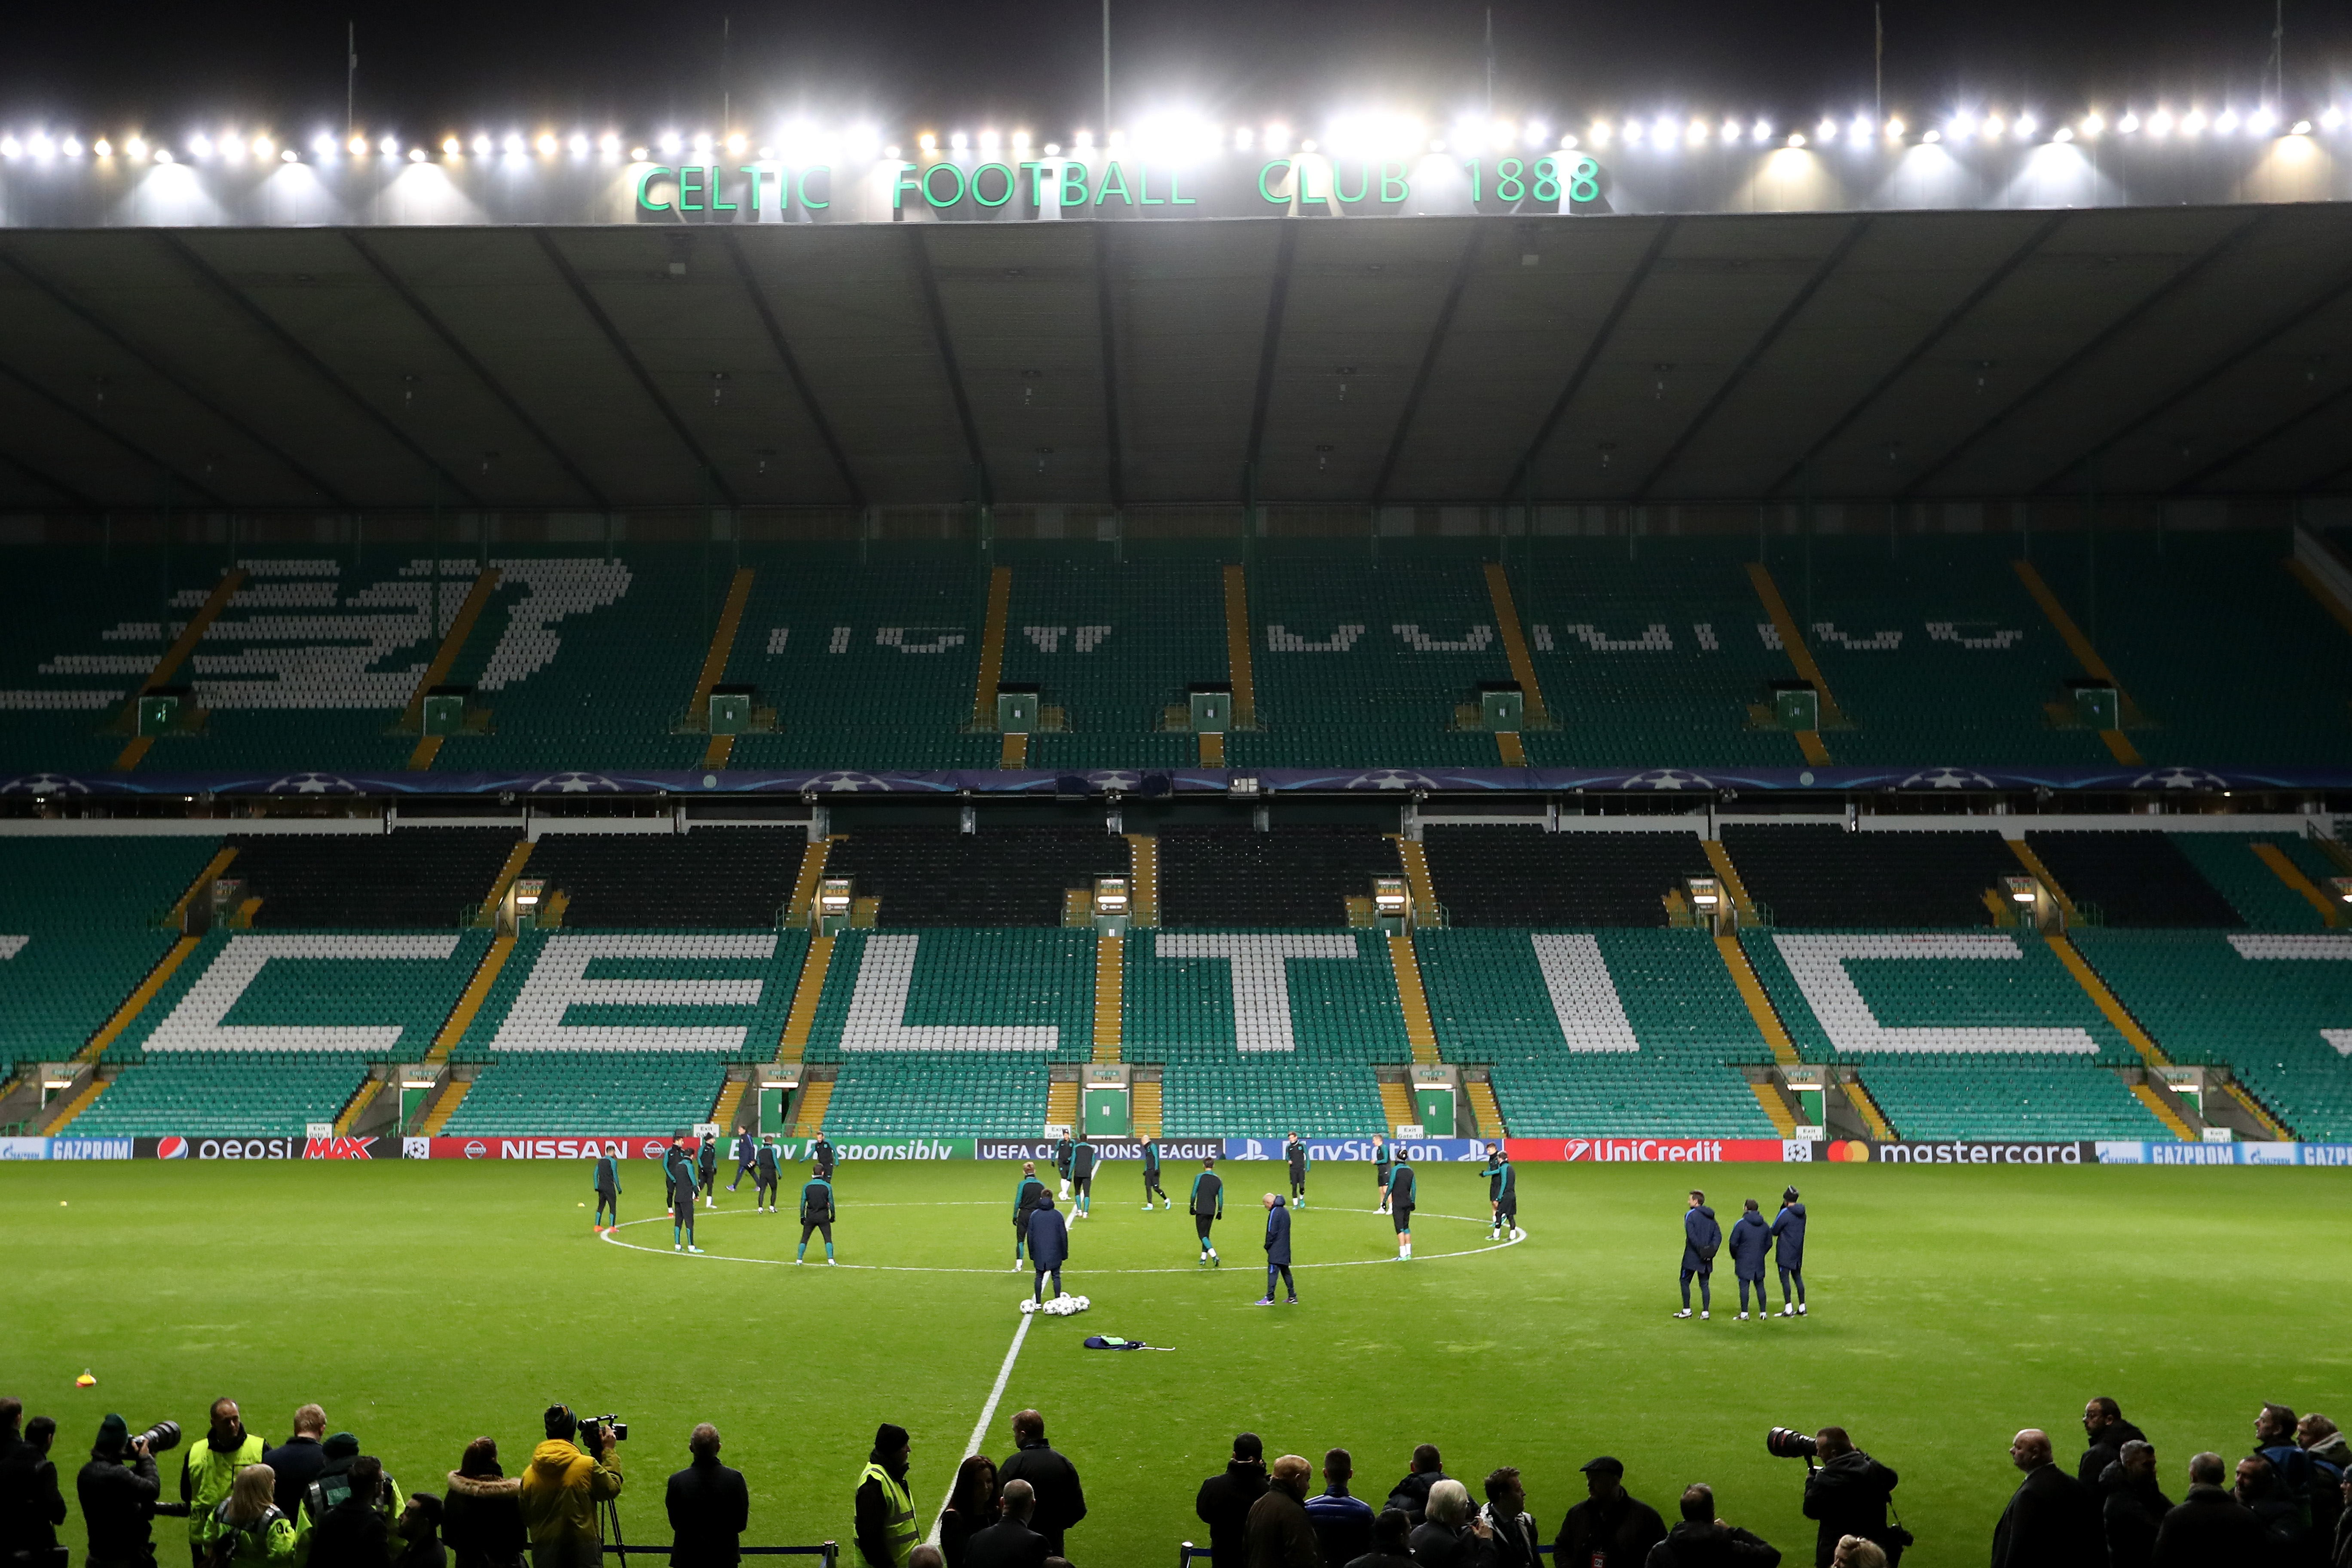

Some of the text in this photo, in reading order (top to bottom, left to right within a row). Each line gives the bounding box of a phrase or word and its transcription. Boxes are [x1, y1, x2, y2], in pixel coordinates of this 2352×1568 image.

[636, 156, 1600, 212] CELTIC FOOTBALL CLUB 1888
[141, 934, 2101, 1054] CELTIC
[54, 1140, 129, 1159] GAZPROM
[199, 1136, 380, 1159] pepsi MAX
[502, 1140, 628, 1159] NISSAN
[804, 1139, 953, 1160] Rsponsibly
[983, 1144, 1217, 1159] UEFA CHIONS EAGUE
[1595, 1140, 1722, 1162] UniCredit
[1880, 1140, 2081, 1164] mastercard
[2153, 1145, 2235, 1165] GAZPROM
